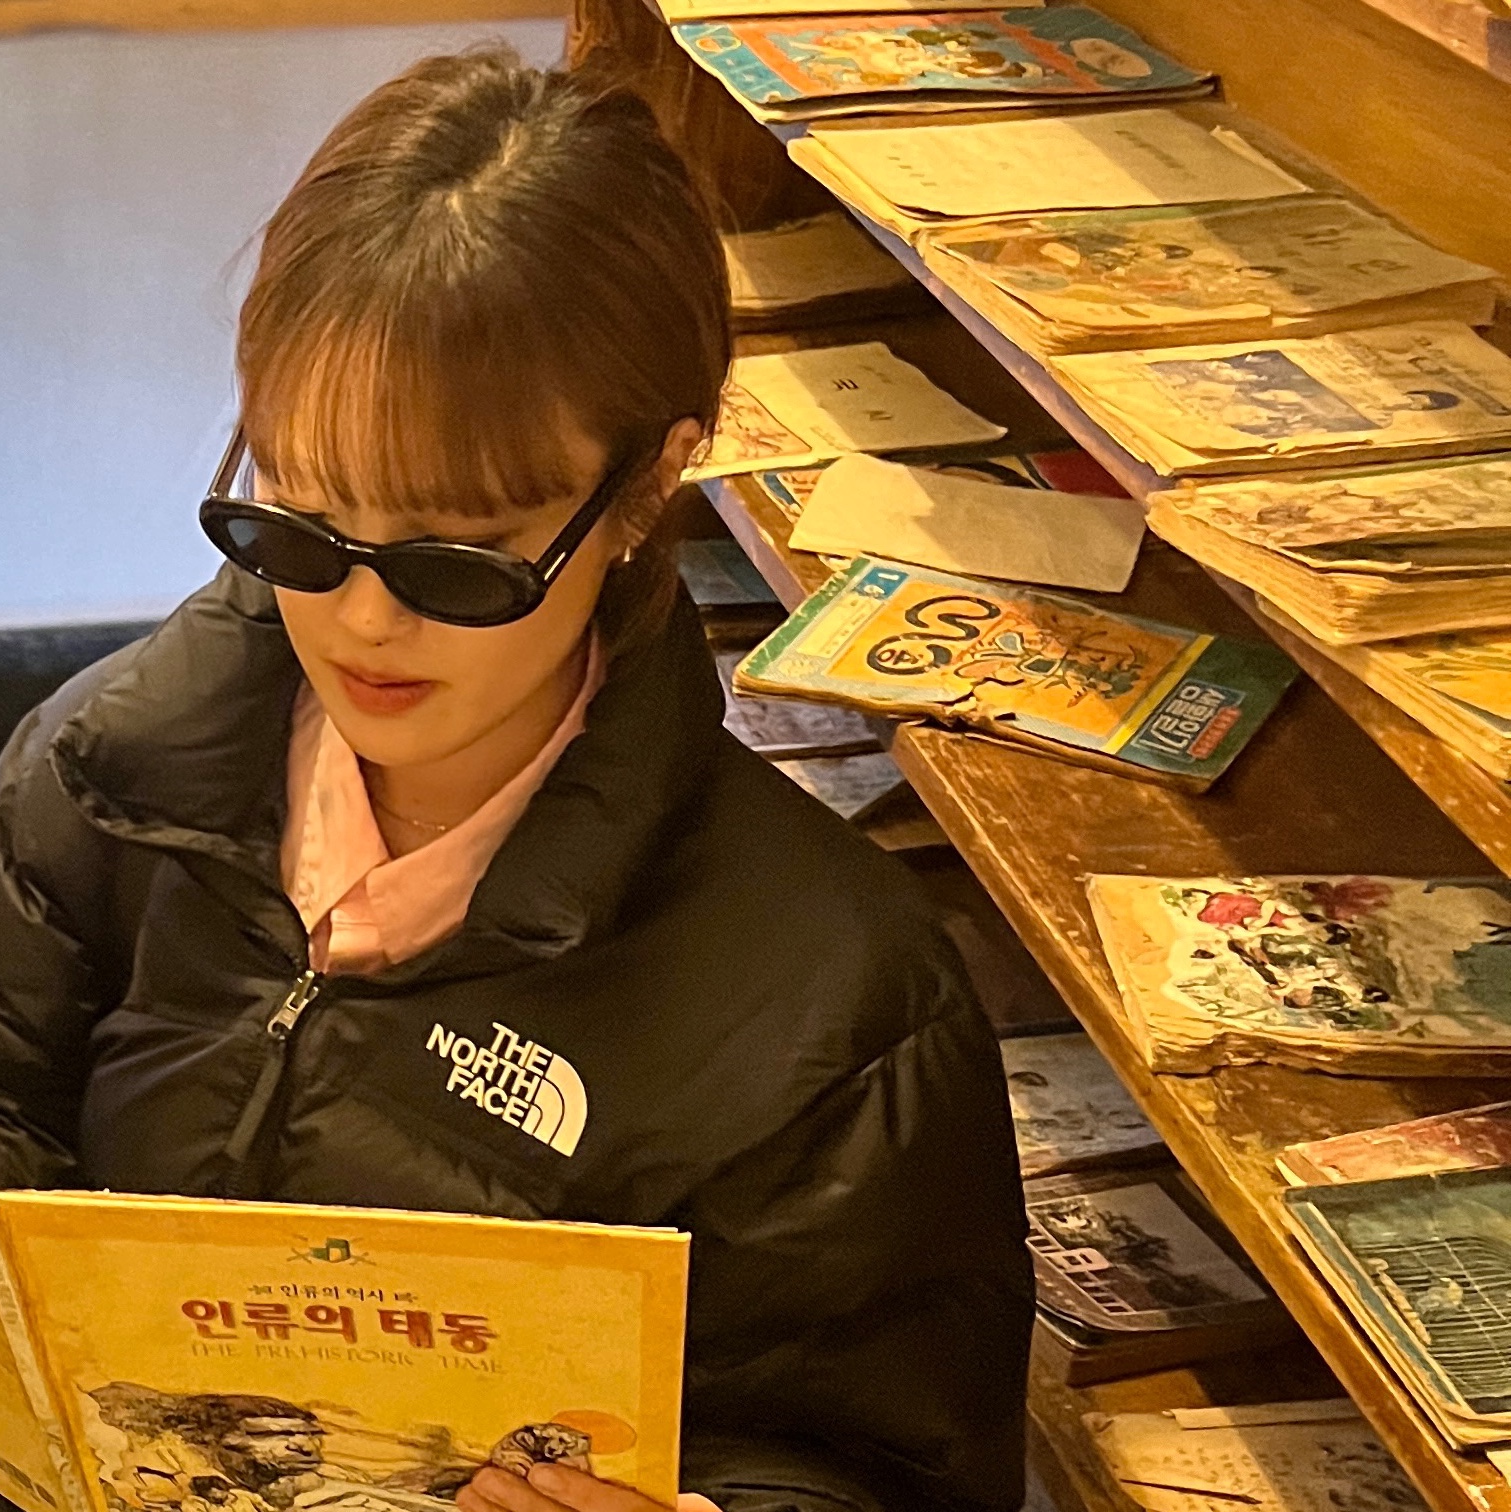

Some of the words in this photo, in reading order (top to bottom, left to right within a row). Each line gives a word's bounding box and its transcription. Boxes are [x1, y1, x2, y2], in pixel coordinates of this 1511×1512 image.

[1139, 685, 1226, 755] 생활일기
[425, 1023, 541, 1103] NORTH
[492, 1021, 553, 1077] THE
[446, 1065, 529, 1128] FACE
[181, 1299, 358, 1344] 인류의
[377, 1309, 499, 1354] 태동
